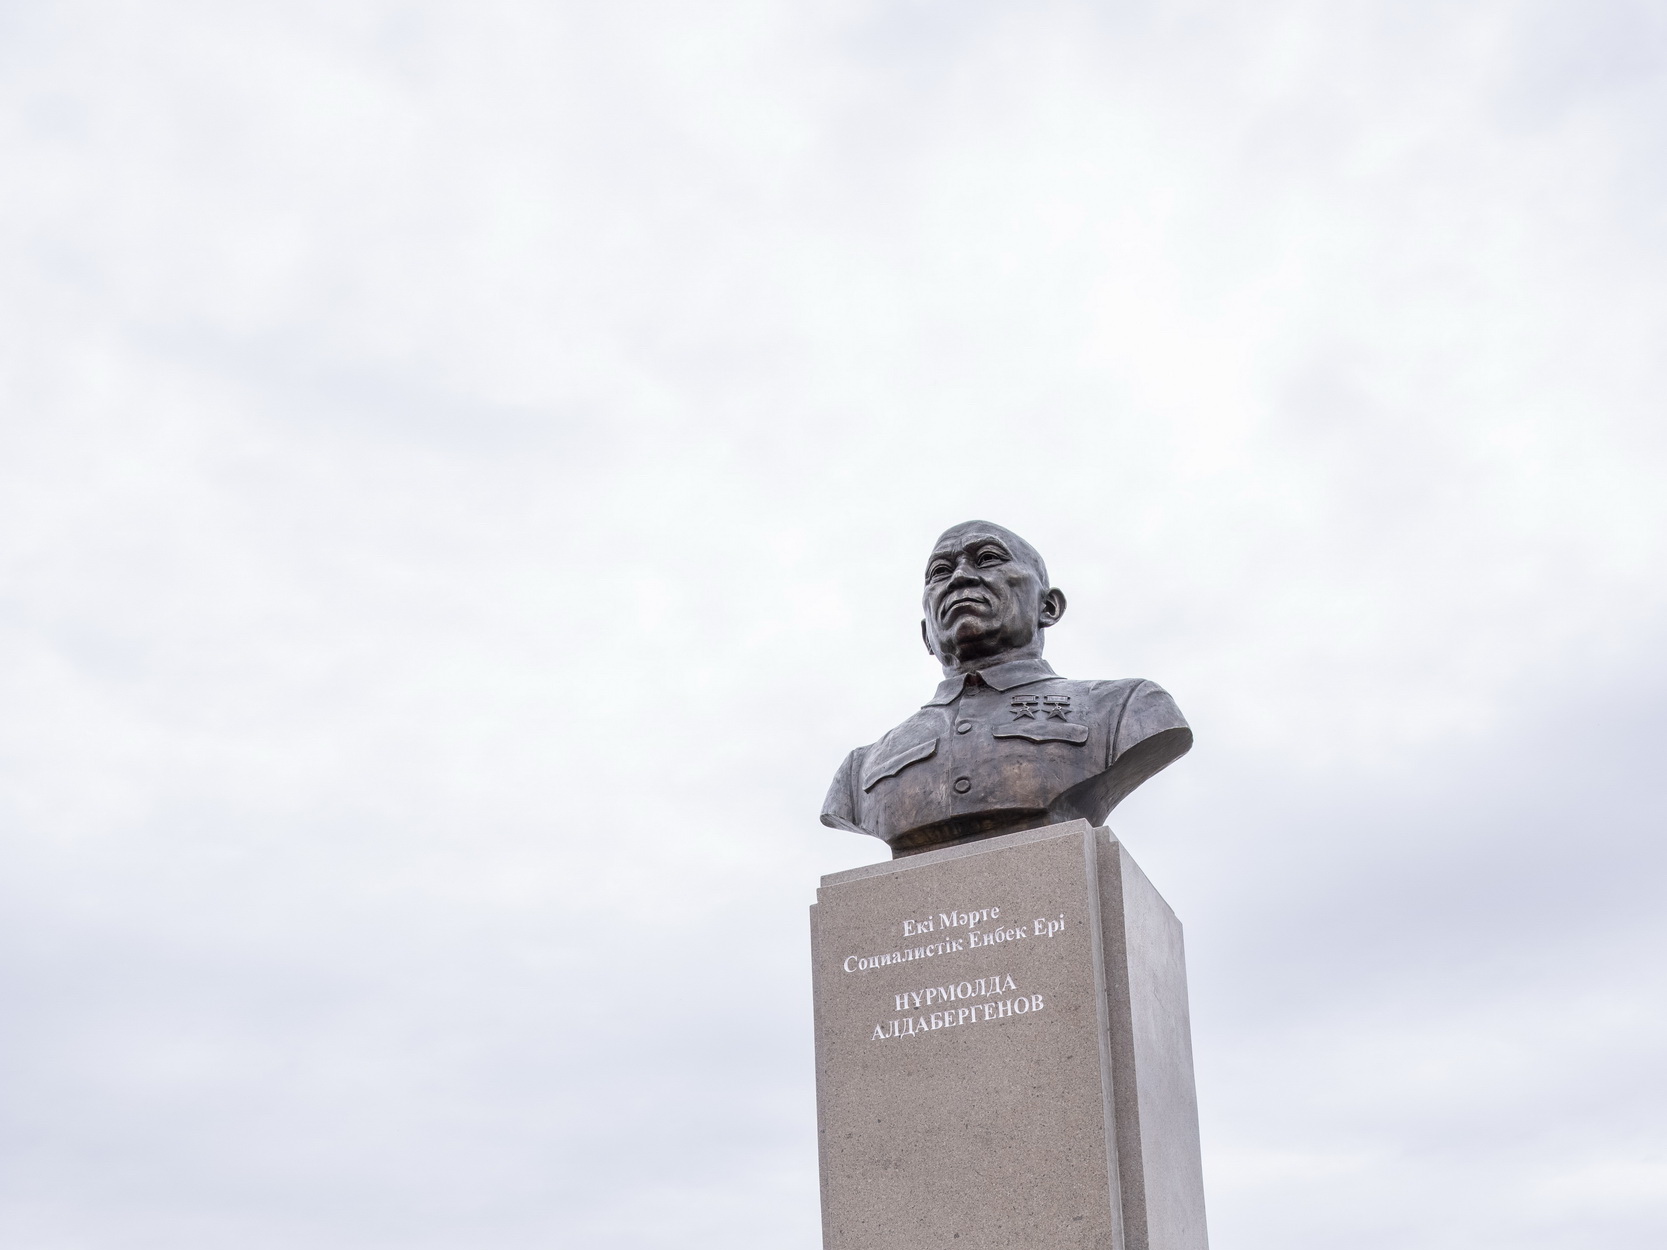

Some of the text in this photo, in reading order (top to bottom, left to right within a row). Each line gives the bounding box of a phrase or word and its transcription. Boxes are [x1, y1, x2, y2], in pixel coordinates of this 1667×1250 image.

[843, 913, 1066, 973] Социалистік Еңбек Ері
[903, 906, 1000, 937] Екі Мәрте
[871, 994, 1044, 1041] АЛДАБЕРГЕНОВ
